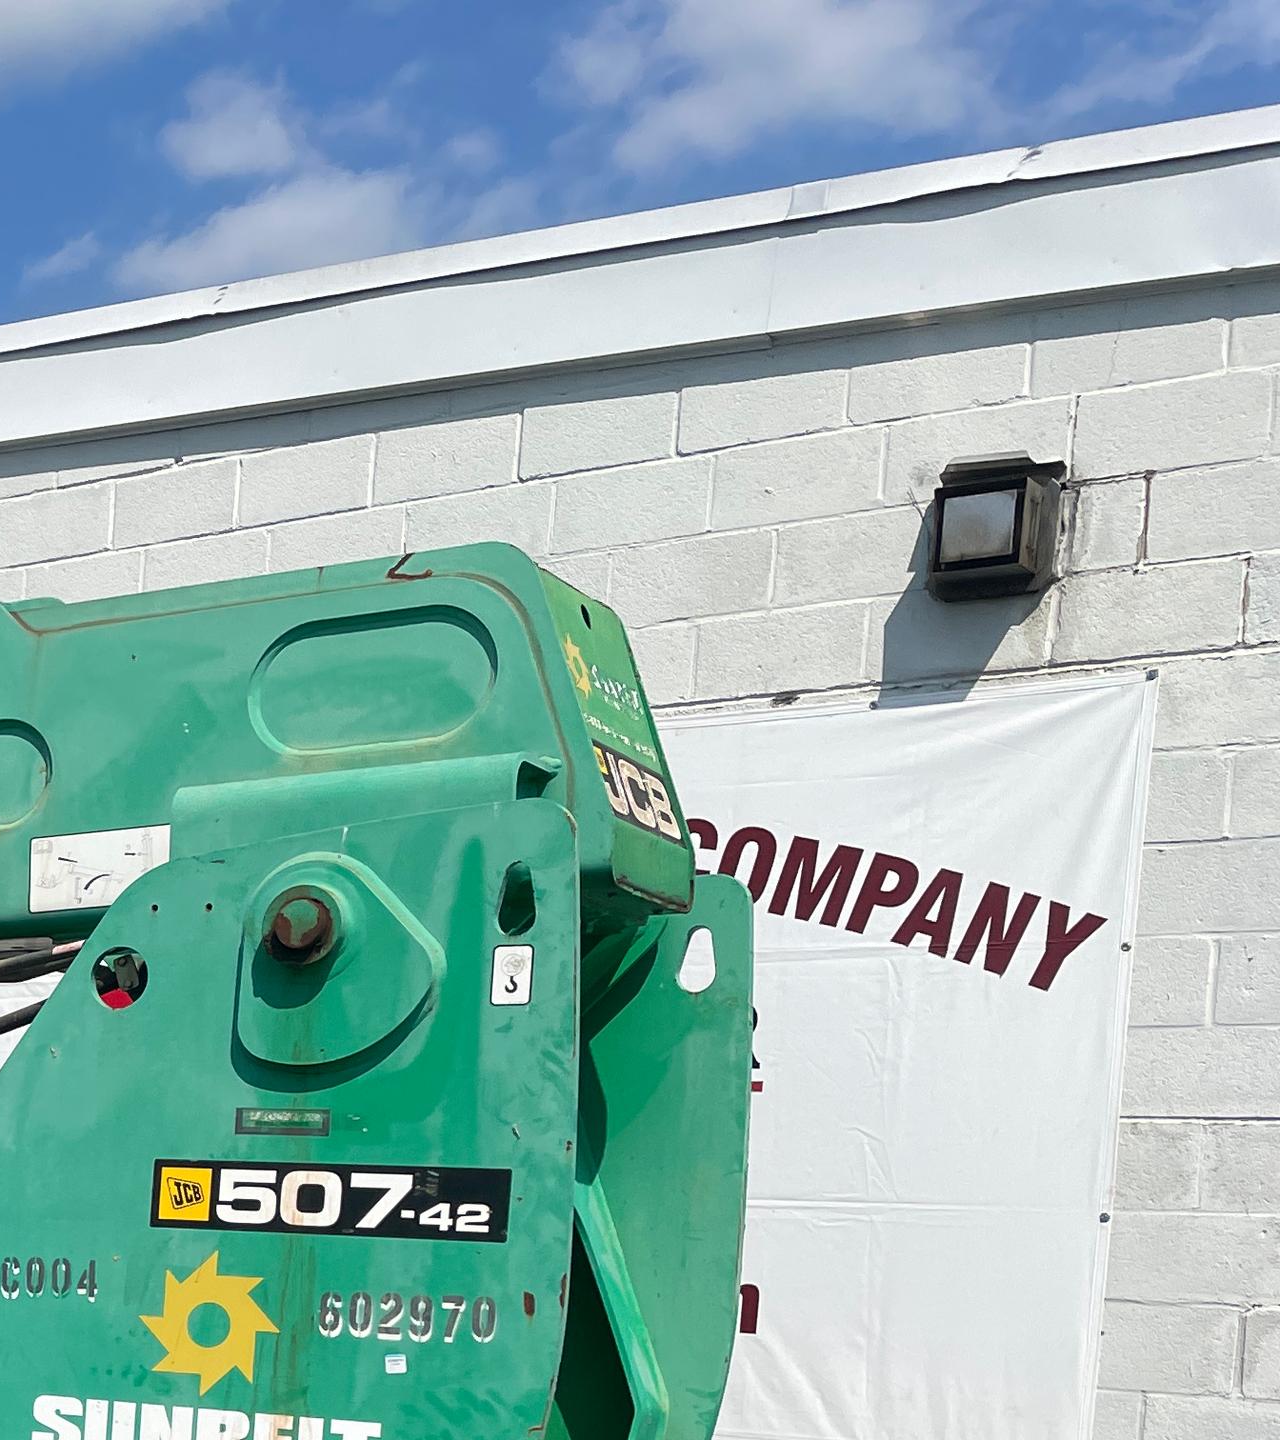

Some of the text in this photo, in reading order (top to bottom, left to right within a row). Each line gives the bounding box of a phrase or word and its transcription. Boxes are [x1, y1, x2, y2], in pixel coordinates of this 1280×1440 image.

[604, 752, 681, 840] JCB
[172, 1168, 490, 1233] JCB 507-42
[318, 1291, 498, 1344] 602970
